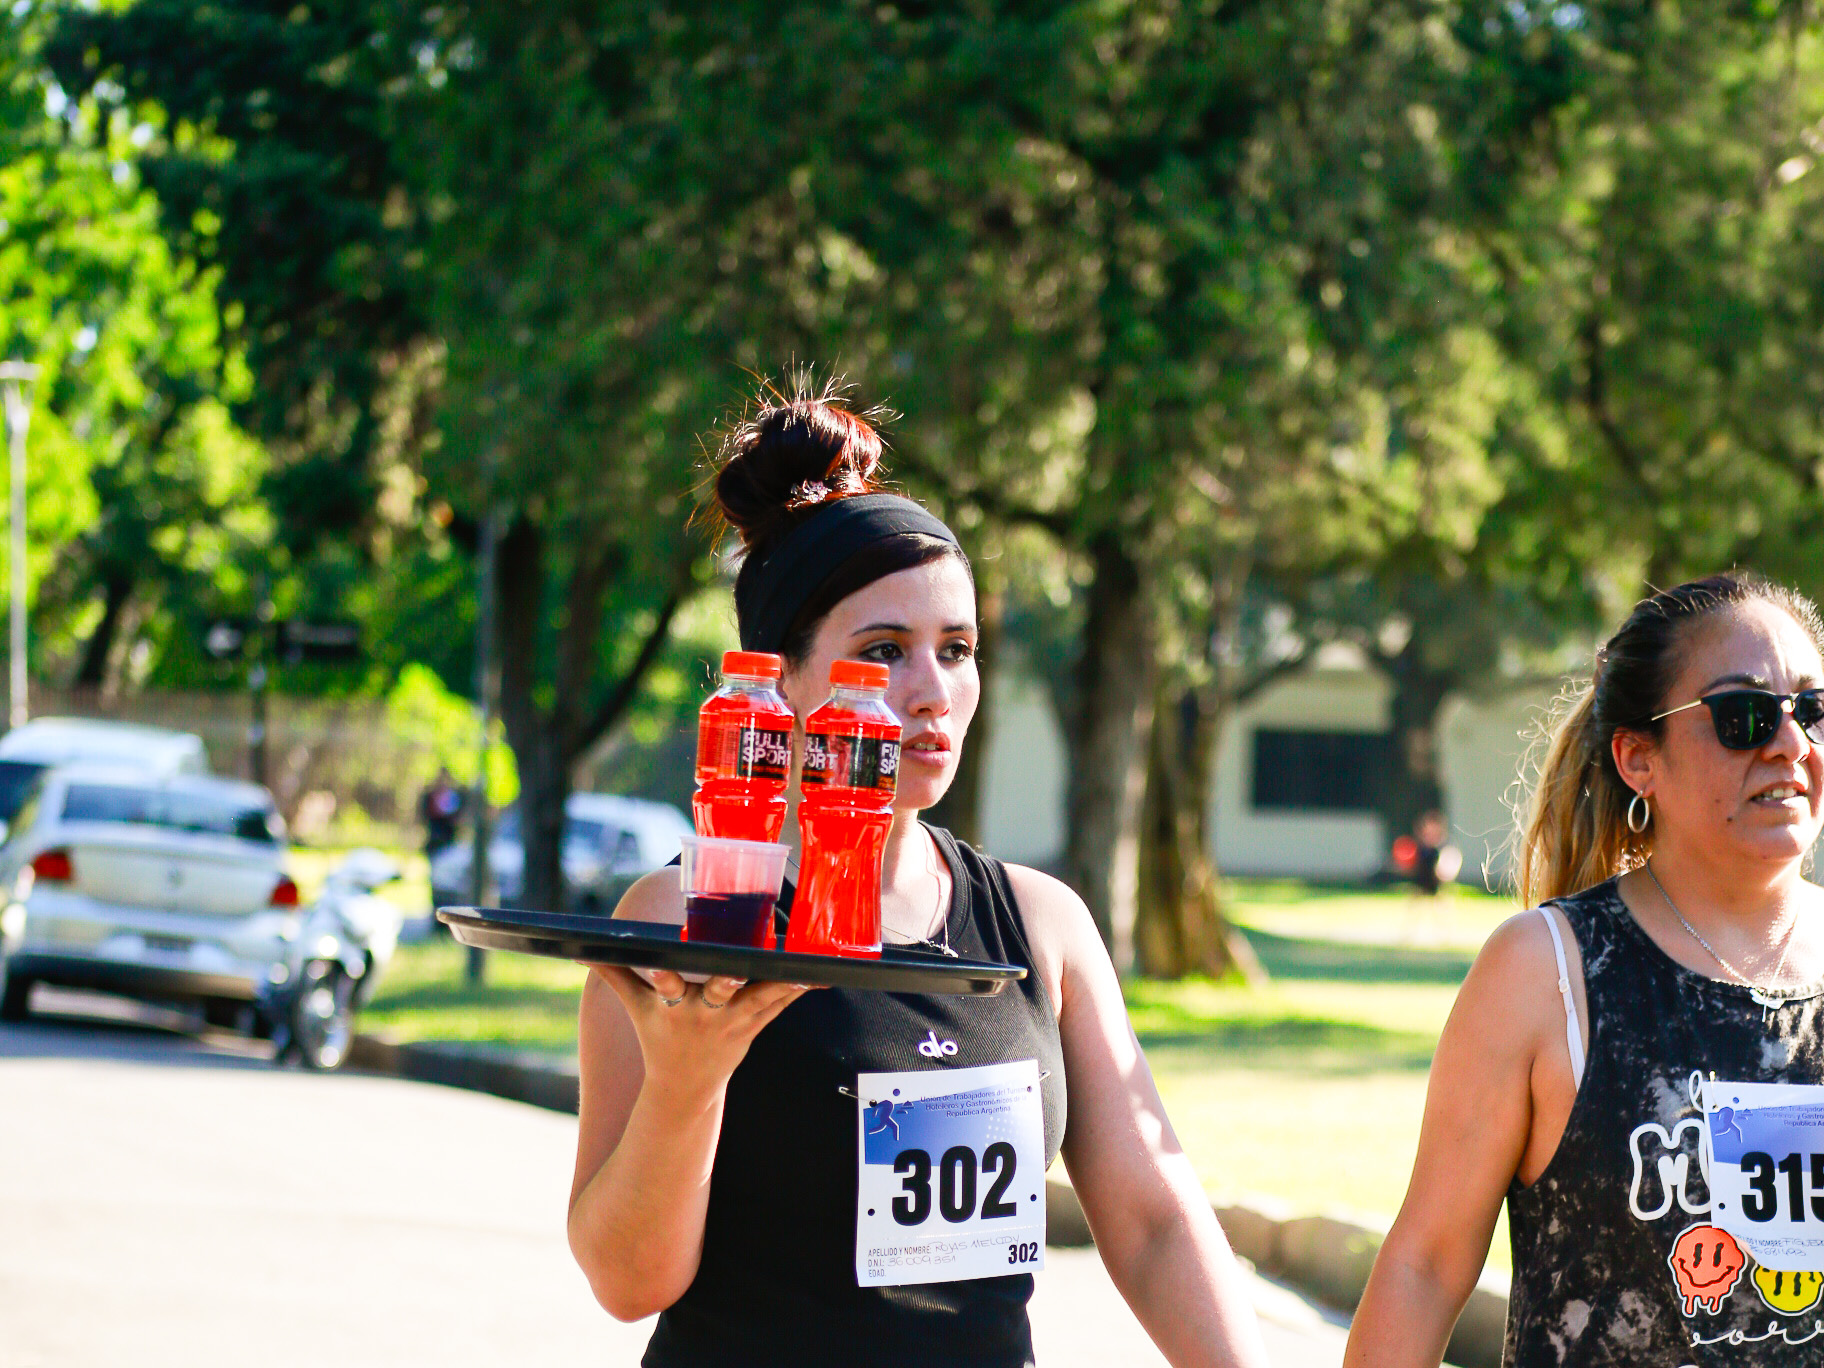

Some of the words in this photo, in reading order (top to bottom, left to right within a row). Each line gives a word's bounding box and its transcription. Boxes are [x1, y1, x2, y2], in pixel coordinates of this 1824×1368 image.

[744, 731, 784, 749] FULL
[743, 746, 791, 766] SPORT
[802, 751, 838, 769] PORT
[880, 758, 897, 774] SP
[952, 1090, 996, 1101] Trabajadores
[925, 1102, 959, 1111] Hoteleros
[980, 1105, 1011, 1115] Argentina
[1801, 1112, 1824, 1120] Gastro
[1629, 1118, 1711, 1221] M
[892, 1141, 1017, 1226] 302
[868, 1247, 898, 1257] APELLIDO
[899, 1247, 904, 1256] Y
[1008, 1242, 1038, 1265] 302
